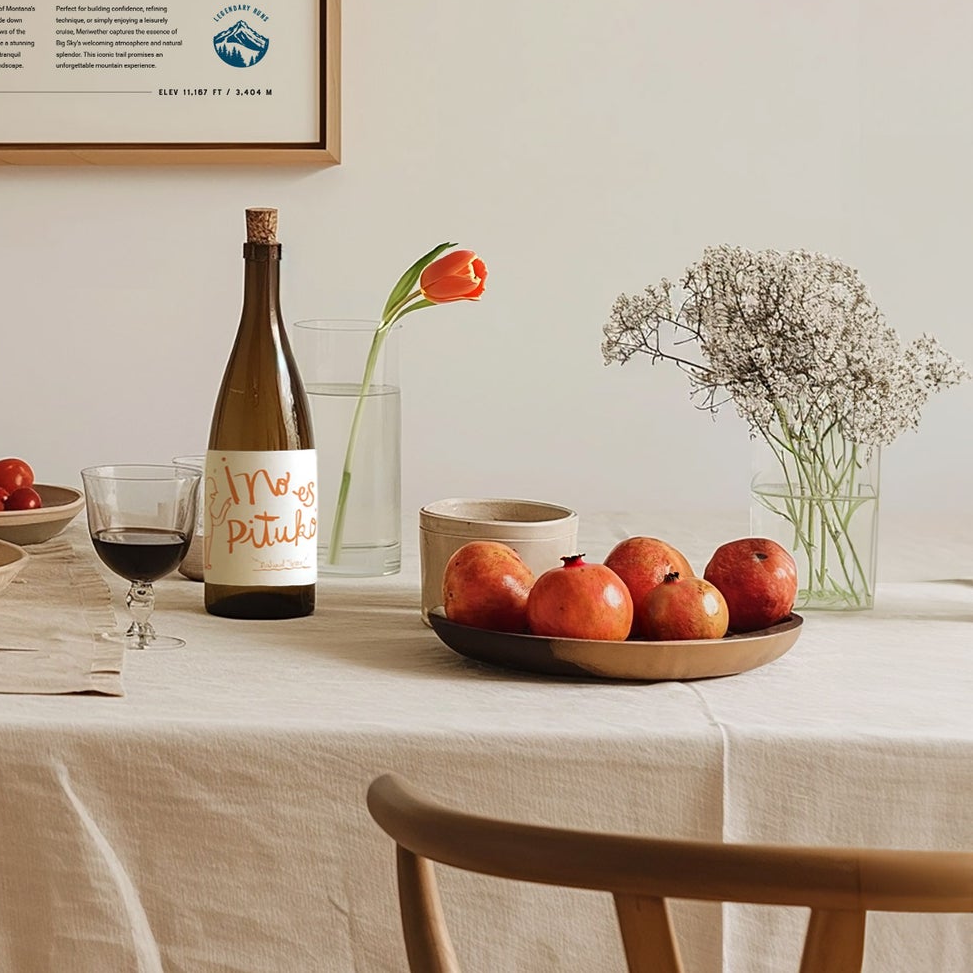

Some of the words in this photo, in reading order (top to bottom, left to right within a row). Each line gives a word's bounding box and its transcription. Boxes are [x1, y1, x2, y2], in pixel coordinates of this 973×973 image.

[87, 5, 110, 13] building
[111, 5, 144, 13] confidence,
[146, 5, 167, 13] refining
[213, 4, 251, 22] LEGENDARY
[252, 7, 269, 22] RUNS
[94, 17, 113, 25] simply
[113, 17, 138, 25] enjoying
[144, 17, 168, 25] leisurely
[10, 40, 35, 48] stunning
[56, 40, 65, 48] Big
[67, 39, 81, 48] Sky's
[82, 40, 114, 48] welcoming
[0, 51, 21, 59] tranquil
[56, 51, 82, 59] splendor.
[128, 51, 154, 59] promises
[56, 62, 94, 70] unforgettable
[226, 88, 230, 96] /
